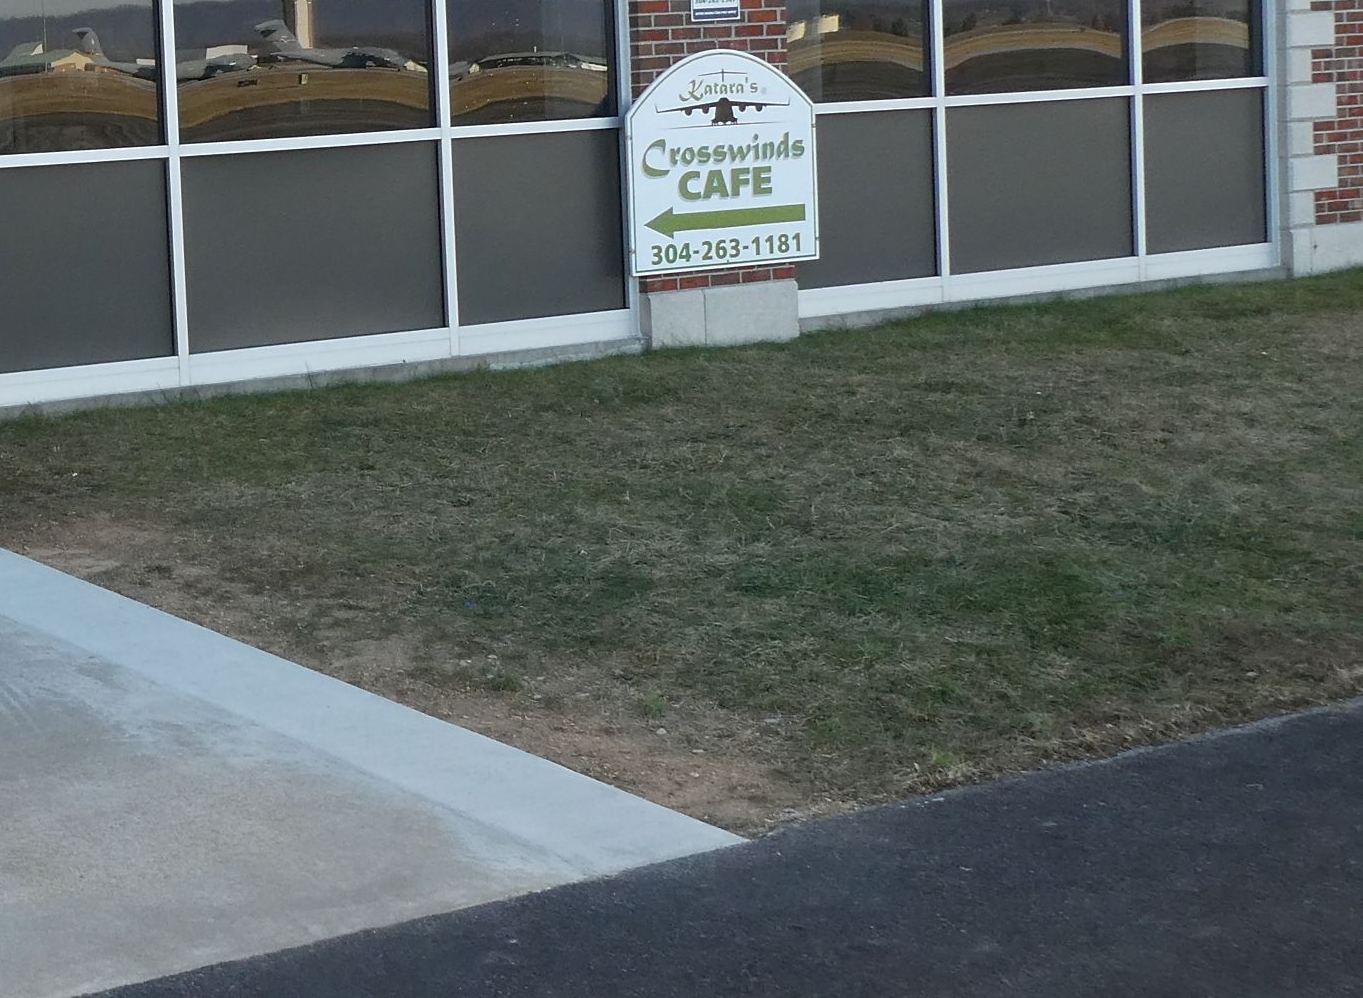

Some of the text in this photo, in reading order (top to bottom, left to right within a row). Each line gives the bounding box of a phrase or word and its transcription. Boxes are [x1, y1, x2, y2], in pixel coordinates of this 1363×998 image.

[679, 77, 758, 101] Katara's
[642, 131, 805, 178] Crosswinds
[677, 165, 773, 201] CAFE
[651, 232, 801, 265] 304-263-1181
